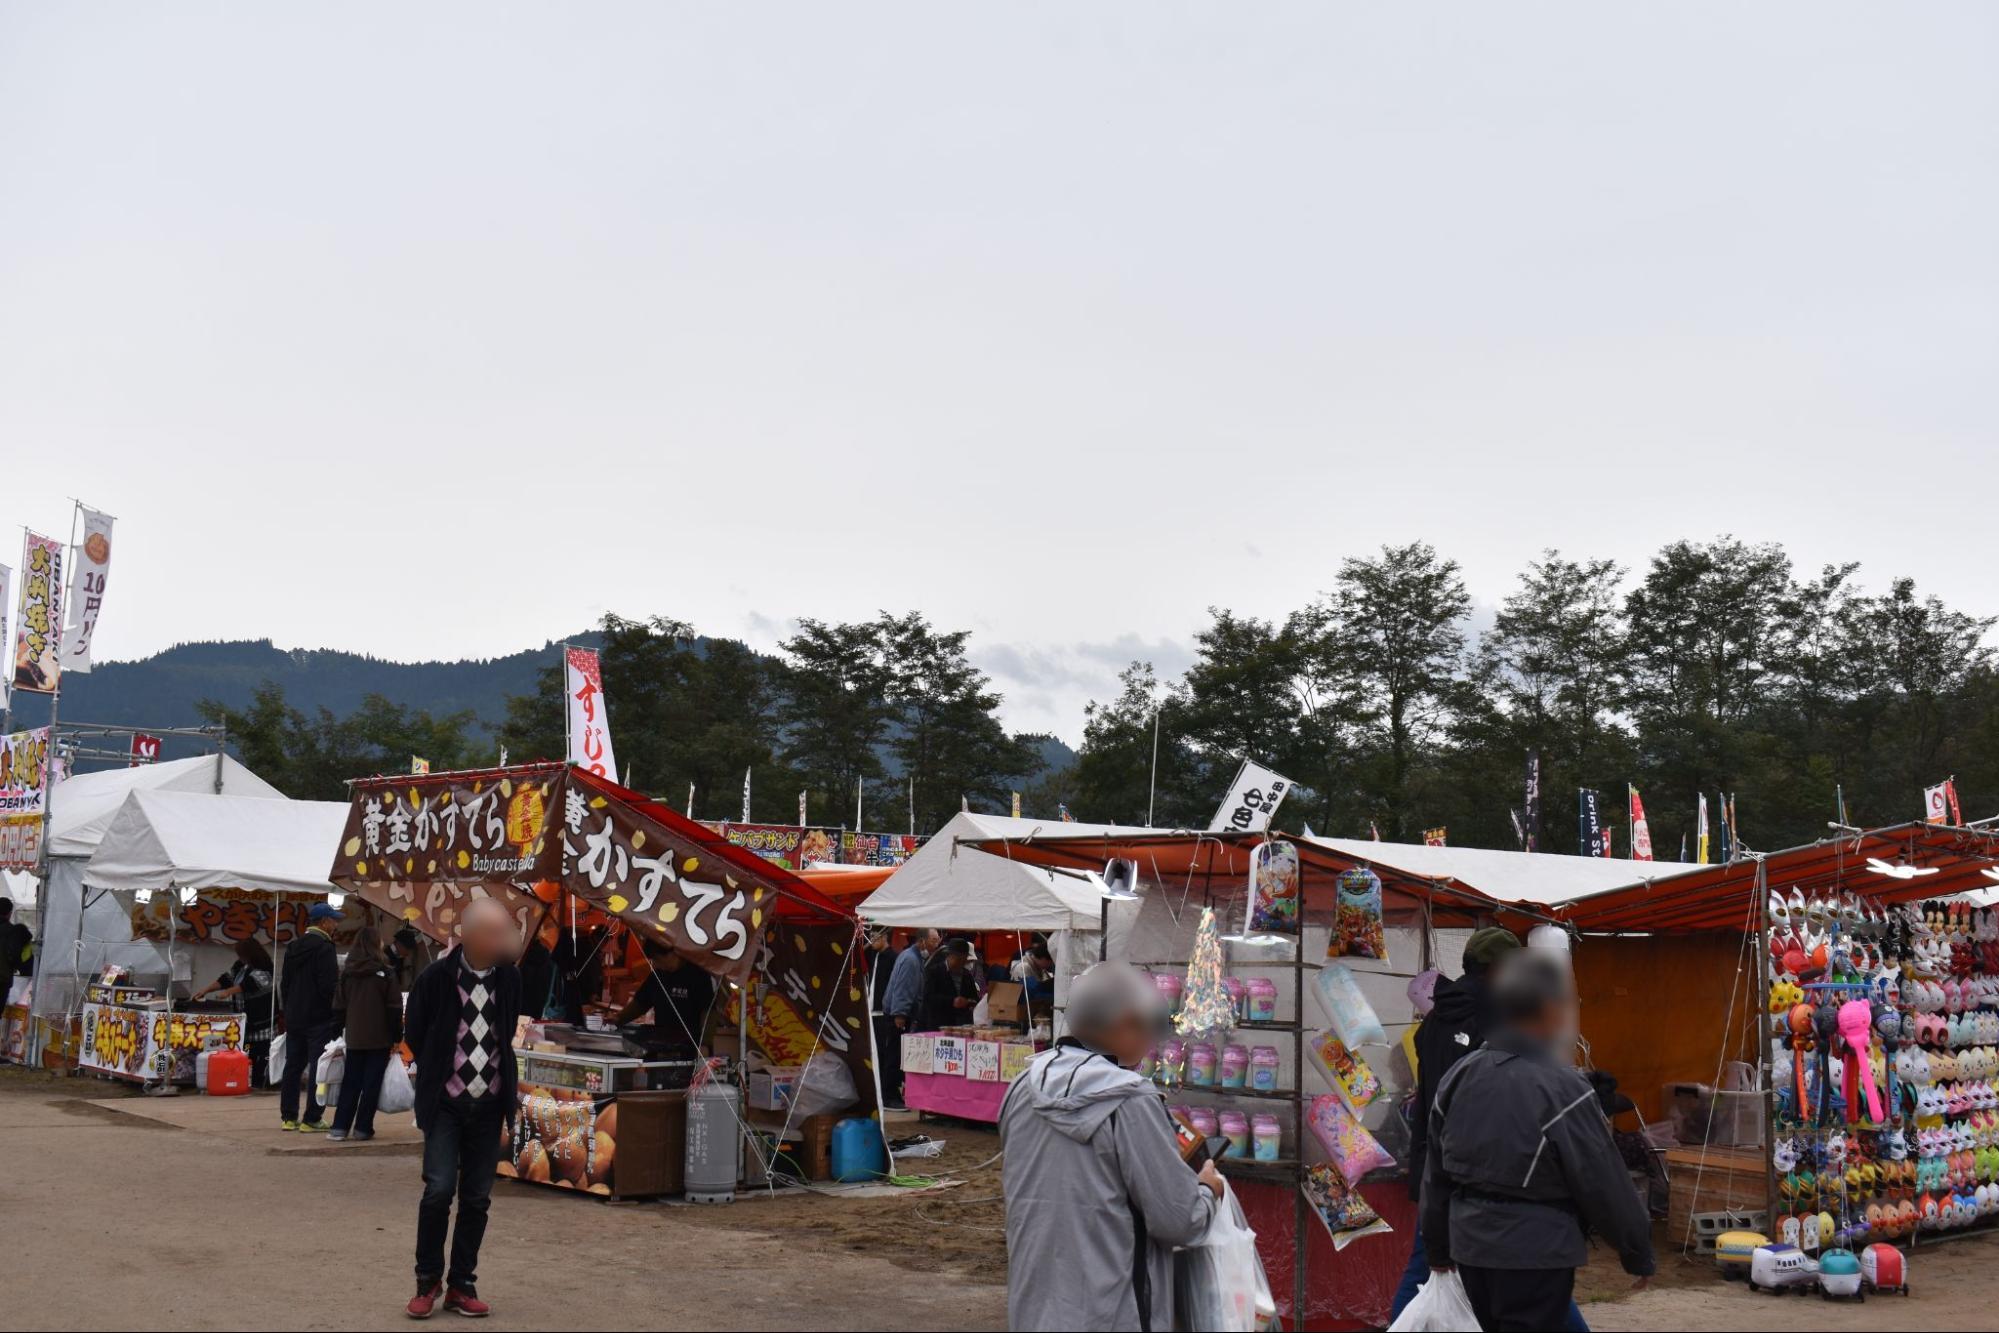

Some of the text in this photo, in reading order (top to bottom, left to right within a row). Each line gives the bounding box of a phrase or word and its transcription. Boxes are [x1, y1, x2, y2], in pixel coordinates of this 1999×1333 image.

[51, 552, 62, 664] OBANYAKI
[1259, 781, 1284, 815] 田中屋
[362, 792, 505, 858] 黄金かすてら
[726, 829, 800, 852] ケバブサンド
[1592, 839, 1601, 858] St
[577, 816, 748, 961] かすてら
